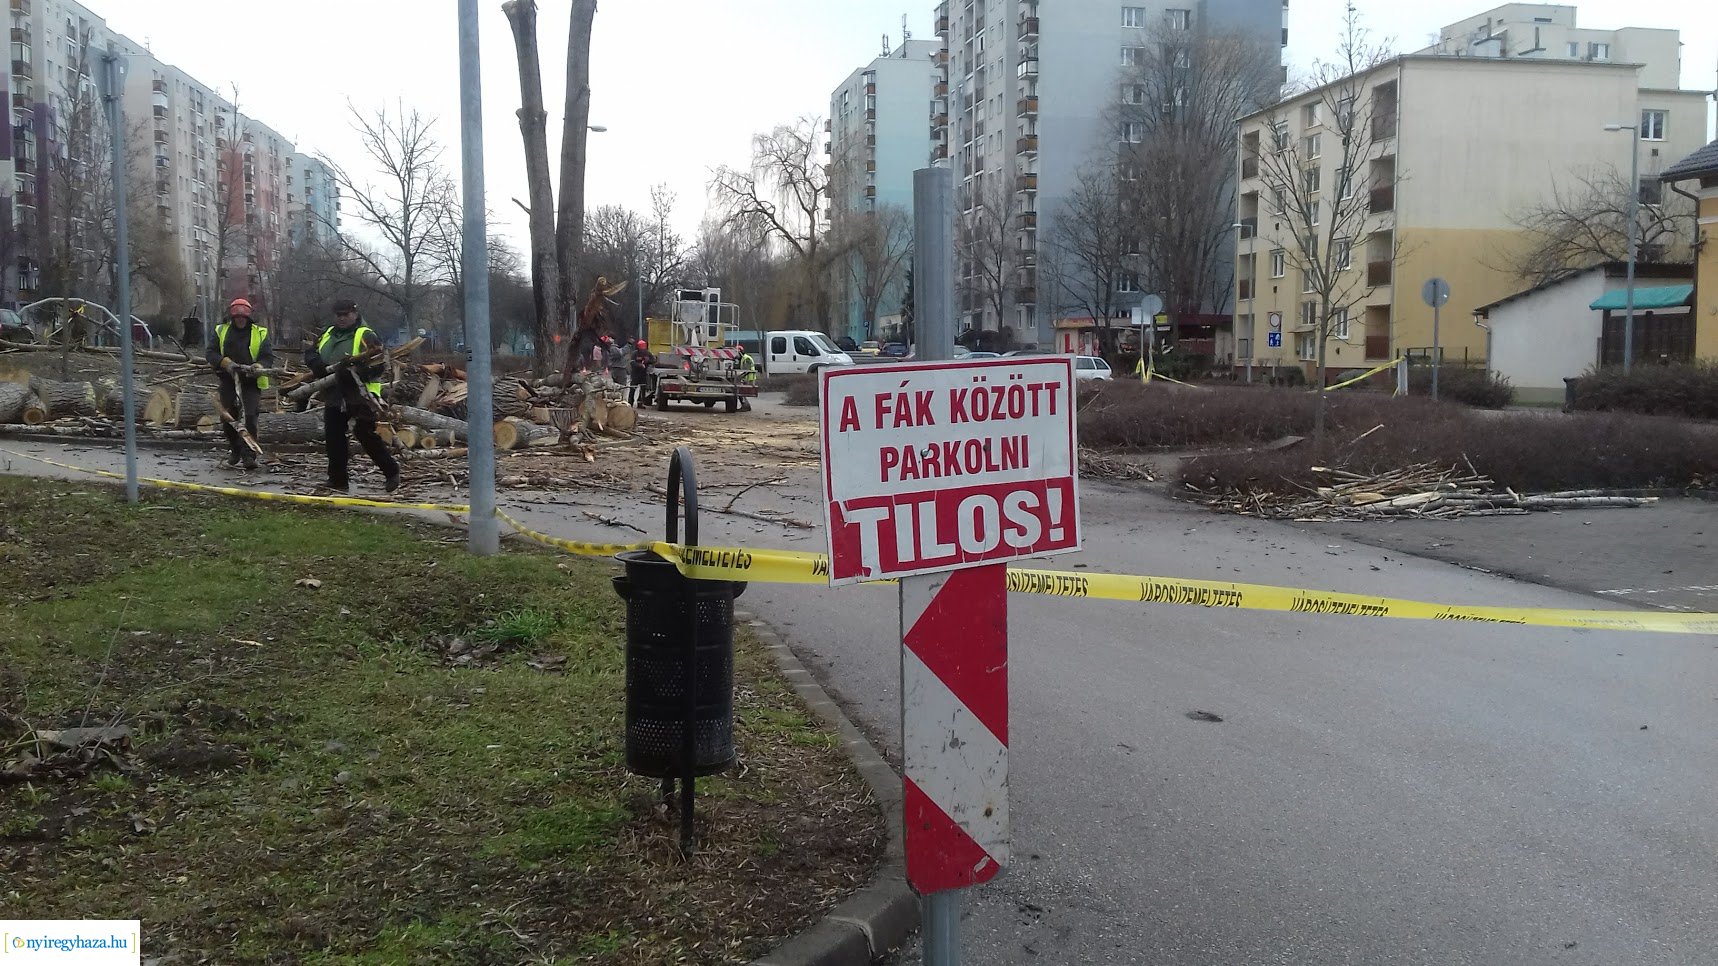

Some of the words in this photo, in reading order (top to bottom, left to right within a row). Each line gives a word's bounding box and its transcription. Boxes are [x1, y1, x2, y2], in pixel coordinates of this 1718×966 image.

[839, 395, 861, 433] A
[875, 379, 936, 430] FÁK
[950, 374, 1061, 424] KÖZÖTT
[880, 434, 1030, 483] PARKOLNI
[844, 487, 1065, 576] TILOS!
